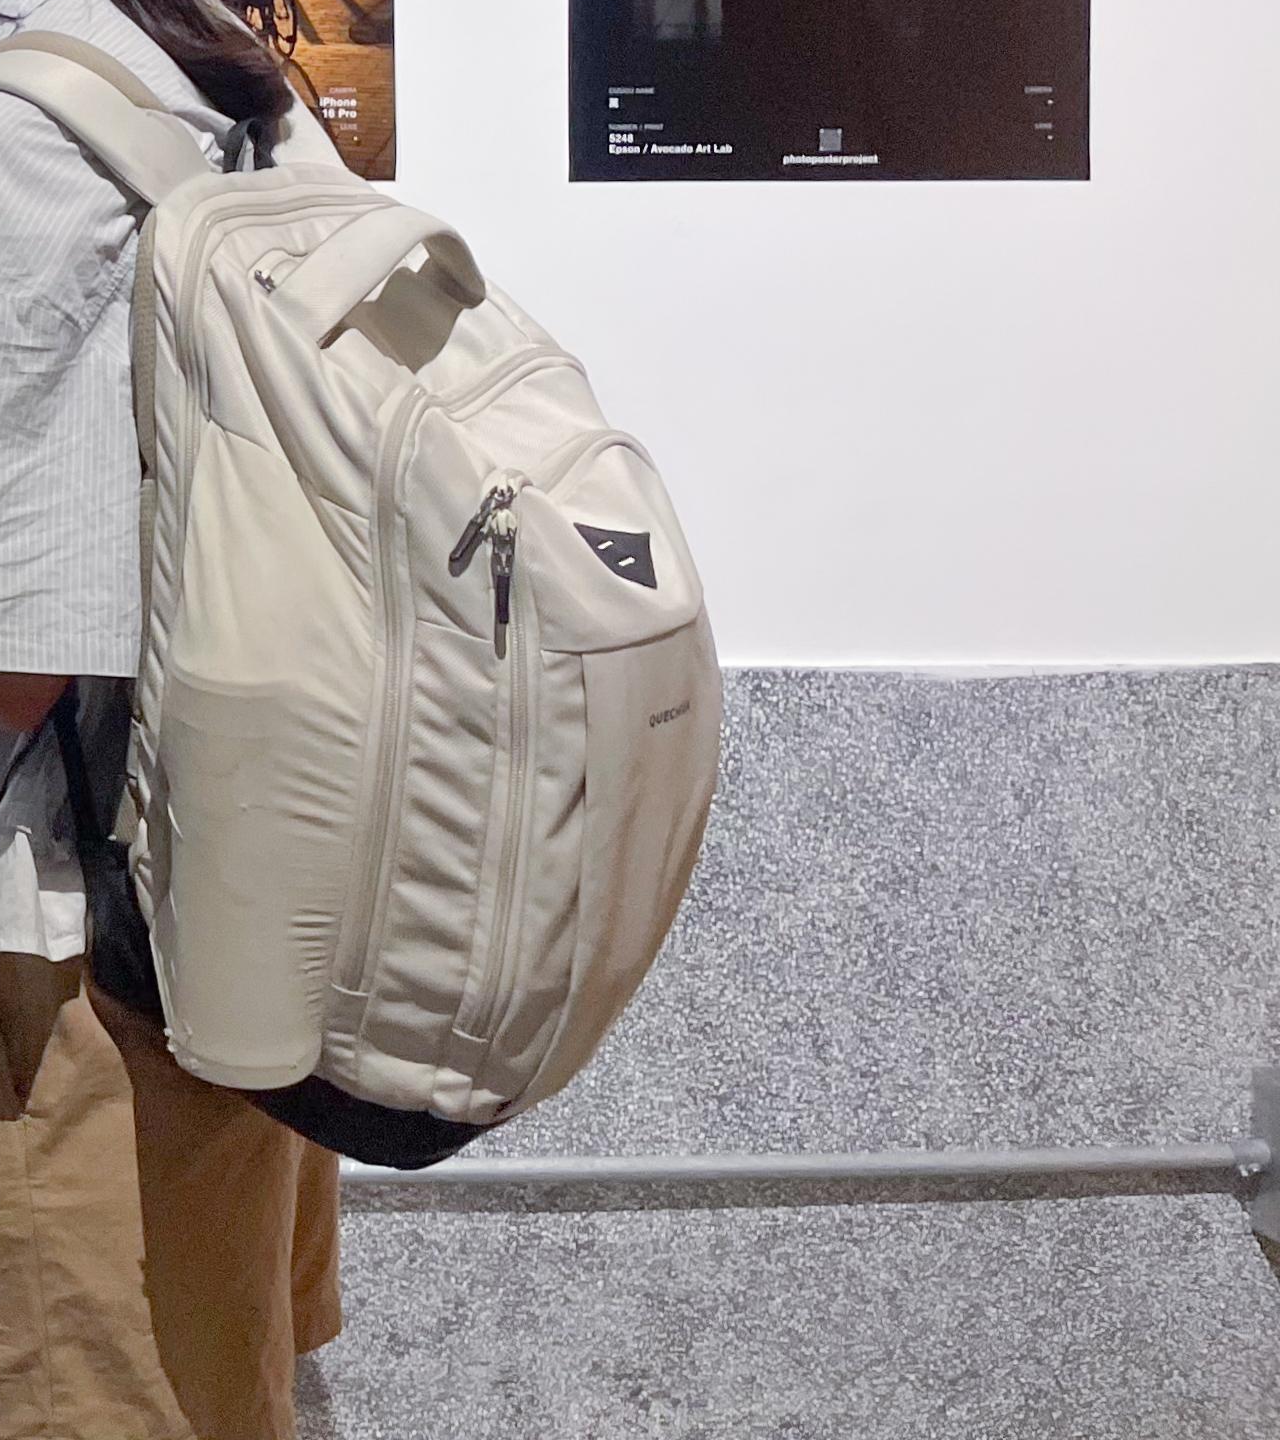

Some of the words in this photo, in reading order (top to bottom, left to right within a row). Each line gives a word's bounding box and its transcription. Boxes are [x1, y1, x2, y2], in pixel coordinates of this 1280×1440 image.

[319, 96, 357, 107] iPhone
[321, 108, 336, 119] 16
[337, 108, 357, 119] Pro
[608, 143, 641, 155] Epson
[650, 143, 694, 154] Avocado
[695, 143, 712, 154] Art
[713, 143, 733, 154] Lab
[782, 154, 879, 165] photoposterproject
